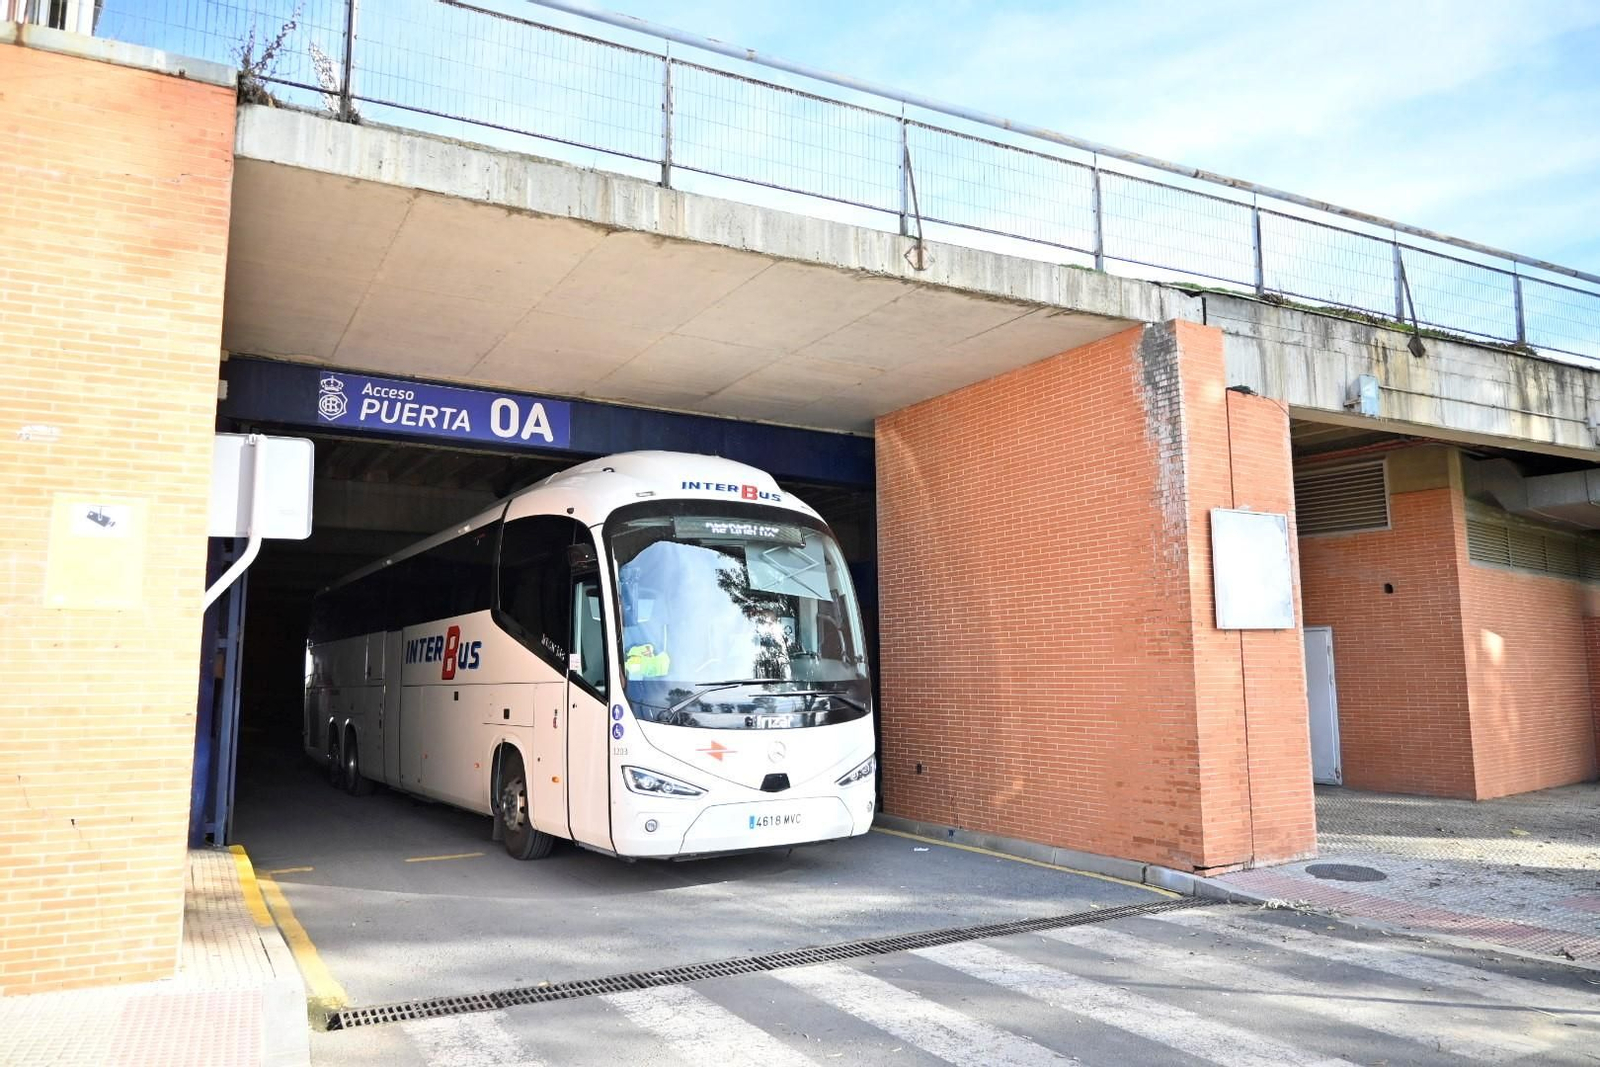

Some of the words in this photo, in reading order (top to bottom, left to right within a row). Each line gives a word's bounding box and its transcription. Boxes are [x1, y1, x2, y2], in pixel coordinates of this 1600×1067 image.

[361, 382, 415, 401] Acceso
[359, 397, 471, 432] PUERTA
[756, 815, 781, 827] 4618
[784, 813, 802, 825] MVC
